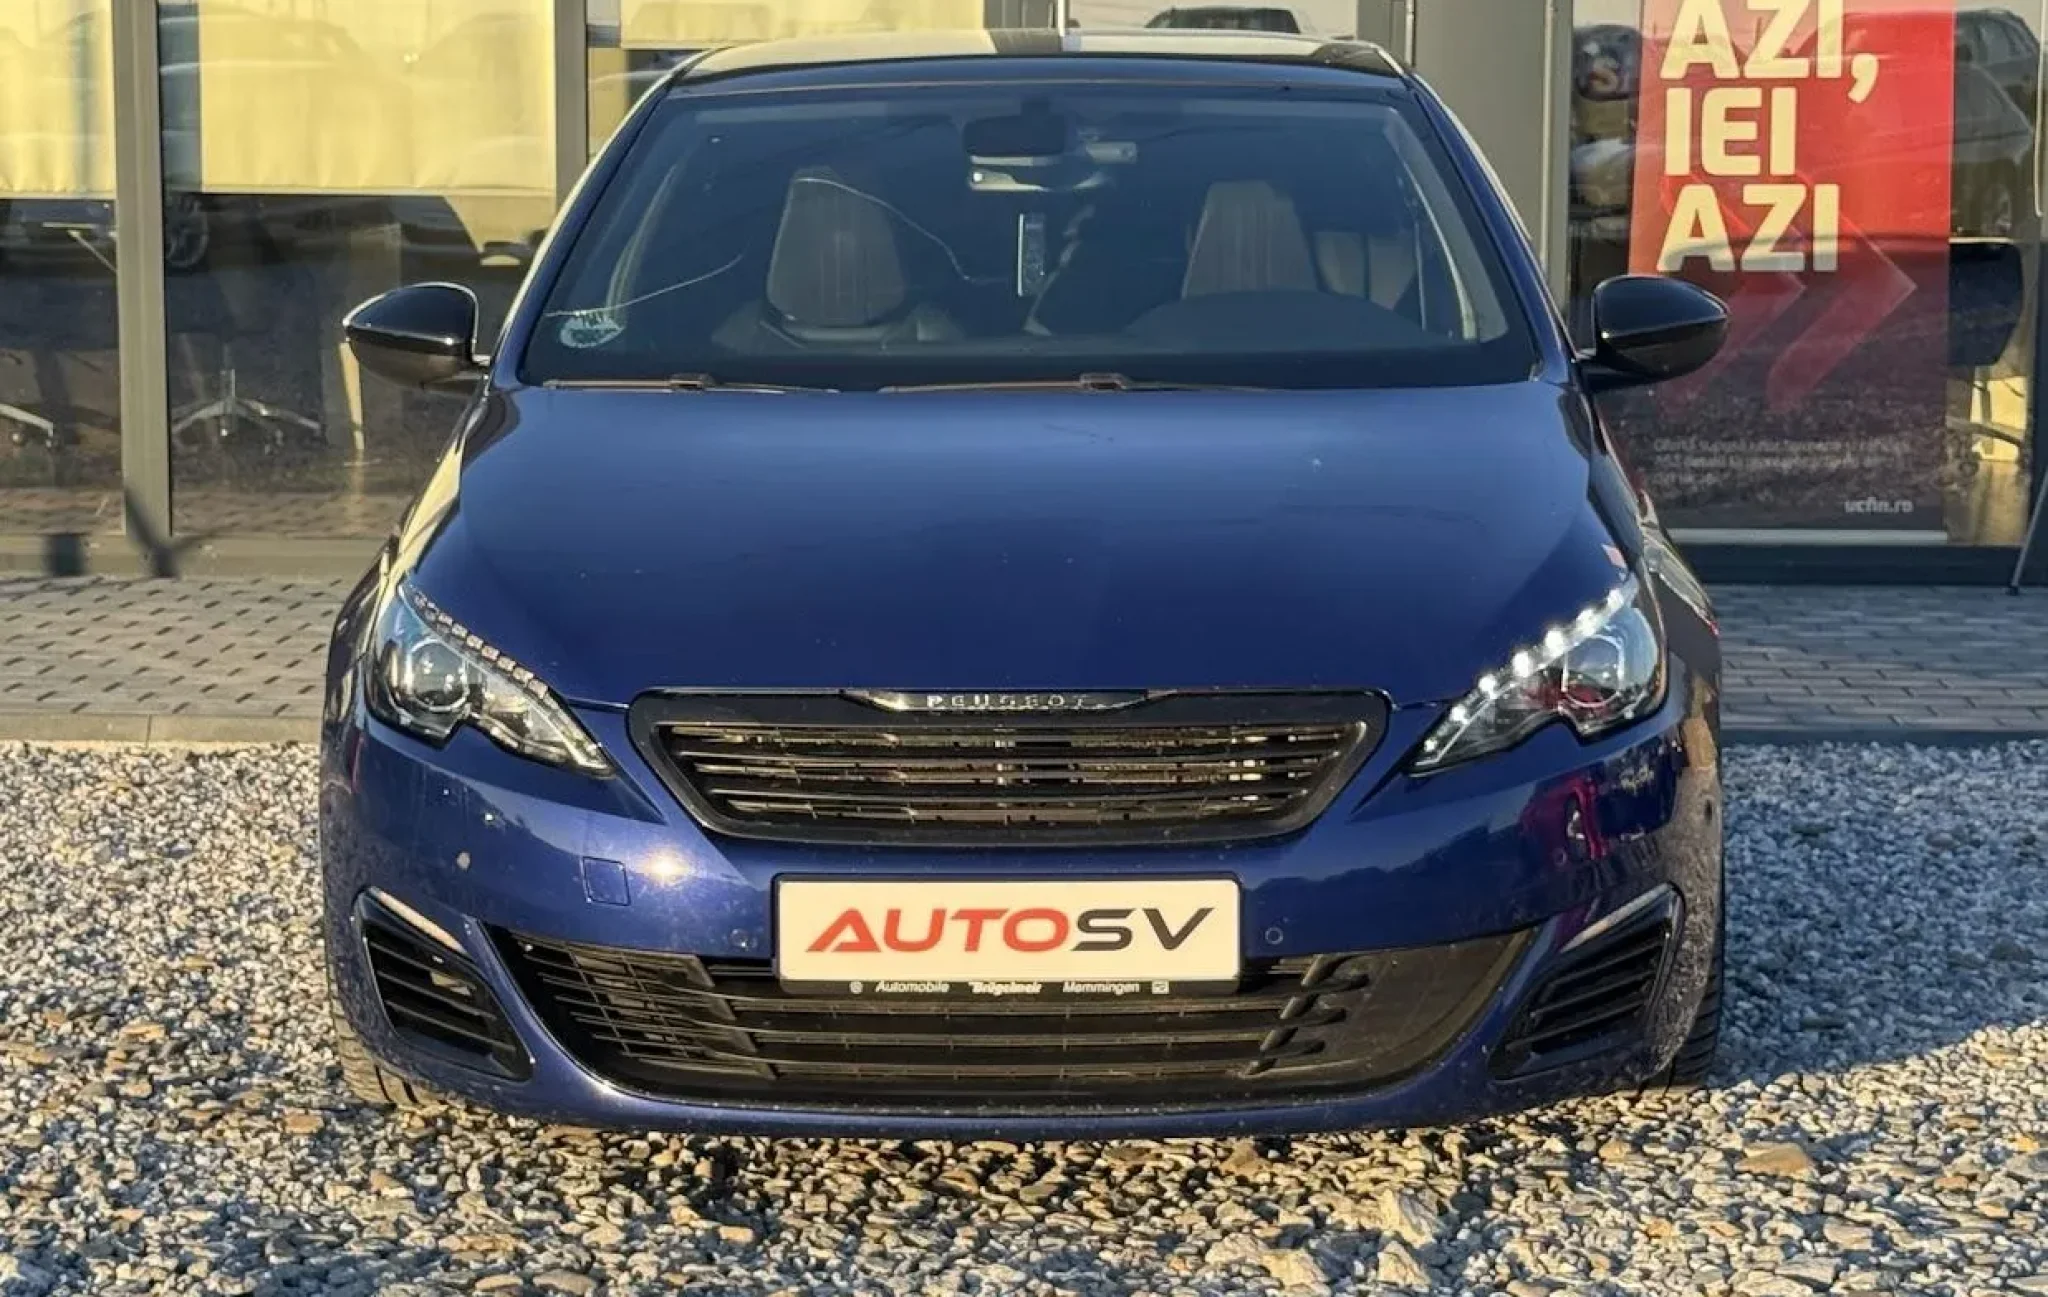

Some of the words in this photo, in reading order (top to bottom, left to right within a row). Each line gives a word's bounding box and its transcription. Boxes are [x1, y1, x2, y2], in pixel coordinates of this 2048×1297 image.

[1659, 0, 1879, 102] AZI,
[1664, 87, 1797, 176] IEI
[1656, 184, 1840, 272] AZI
[926, 694, 1089, 708] PEUGEOT
[875, 980, 950, 993] Automobile
[1062, 980, 1140, 996] Memmingen
